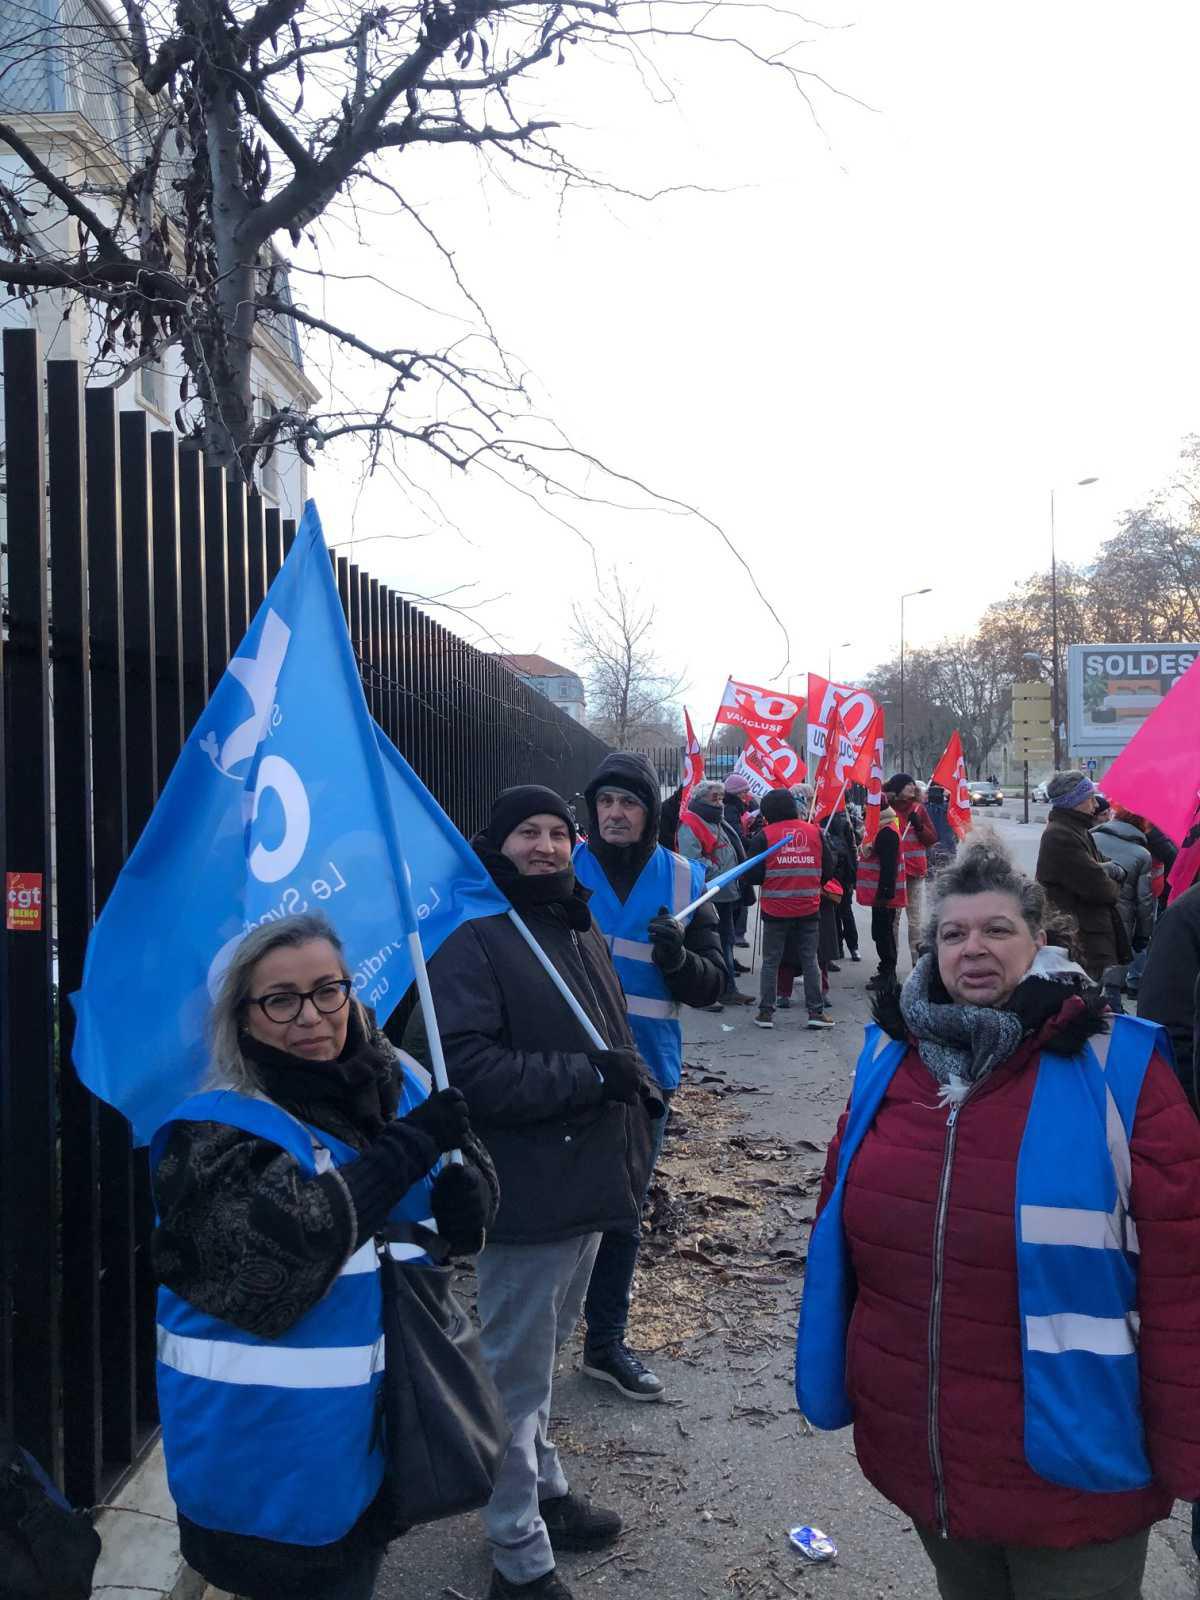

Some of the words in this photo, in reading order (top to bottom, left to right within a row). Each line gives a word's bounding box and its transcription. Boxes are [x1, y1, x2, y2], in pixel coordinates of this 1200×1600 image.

[1086, 654, 1194, 676] SOLDES
[726, 711, 783, 733] VAUCLUSE
[777, 856, 815, 864] VAUCLUSE
[8, 887, 40, 908] cgt
